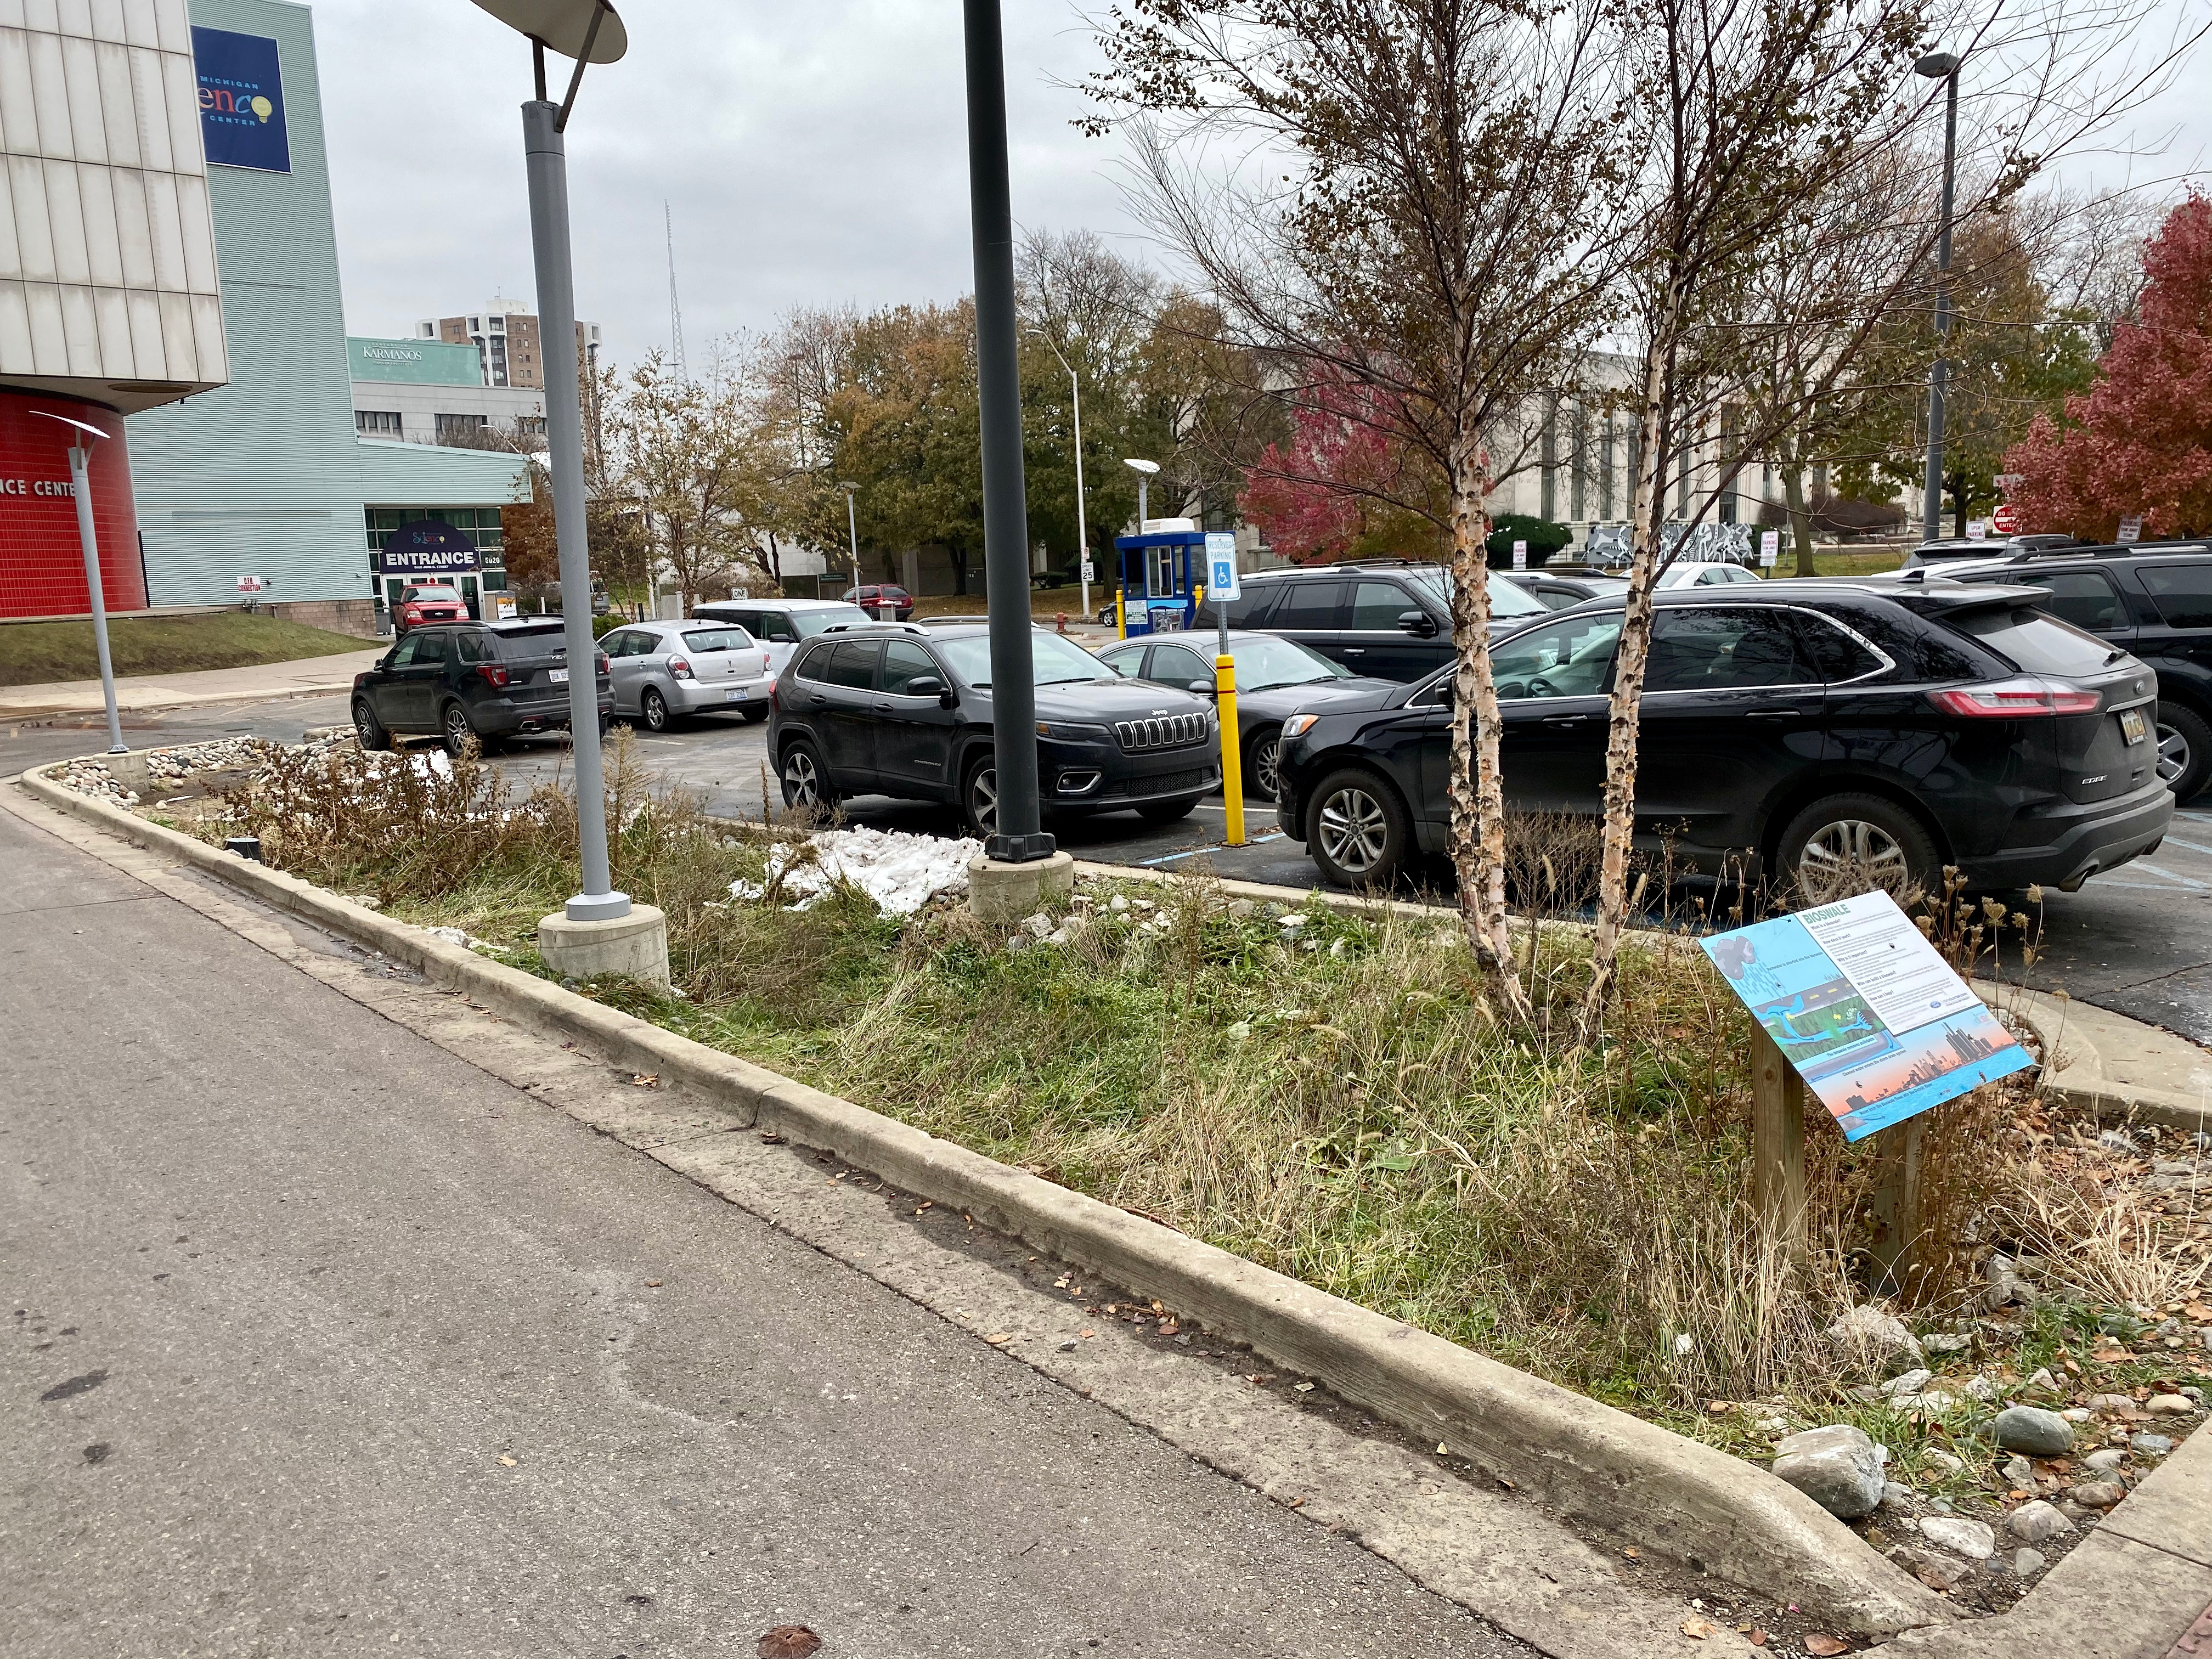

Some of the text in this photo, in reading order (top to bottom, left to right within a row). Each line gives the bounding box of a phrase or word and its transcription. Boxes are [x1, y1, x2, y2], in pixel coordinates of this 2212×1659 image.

[200, 76, 258, 89] MICHIGAN
[210, 115, 255, 126] CENTER
[363, 346, 422, 360] KARMANOS
[34, 481, 75, 496] CENTE
[1208, 540, 1232, 549] RESERVED
[386, 551, 475, 566] ENTRANCE
[1210, 551, 1232, 560] PARKING
[734, 589, 746, 597] ONE
[2081, 775, 2108, 785] EDGE
[1802, 904, 1852, 924] BIOSWALE
